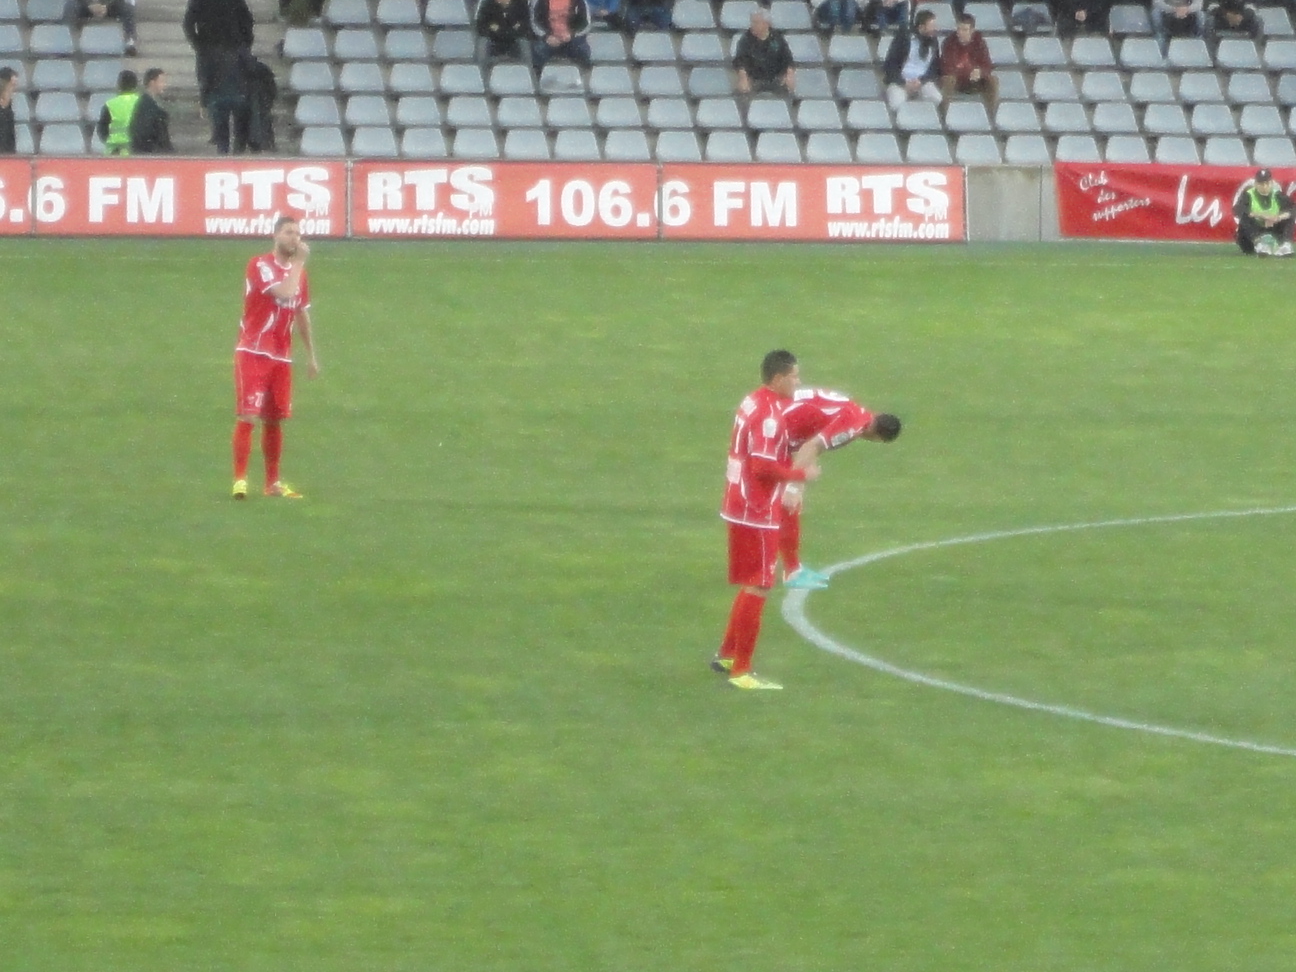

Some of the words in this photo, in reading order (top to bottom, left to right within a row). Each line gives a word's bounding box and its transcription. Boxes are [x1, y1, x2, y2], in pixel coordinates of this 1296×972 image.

[0, 176, 66, 222] .6
[88, 177, 174, 223] FM
[204, 166, 331, 210] RTS
[367, 165, 495, 211] RTS
[826, 171, 949, 214] RTS
[1080, 170, 1108, 191] Club
[1175, 175, 1223, 228] Les
[367, 212, 496, 235] www.rtsfm.com
[525, 179, 691, 227] 106.6
[713, 181, 798, 227] FM
[827, 216, 950, 239] www.rtsfm.com
